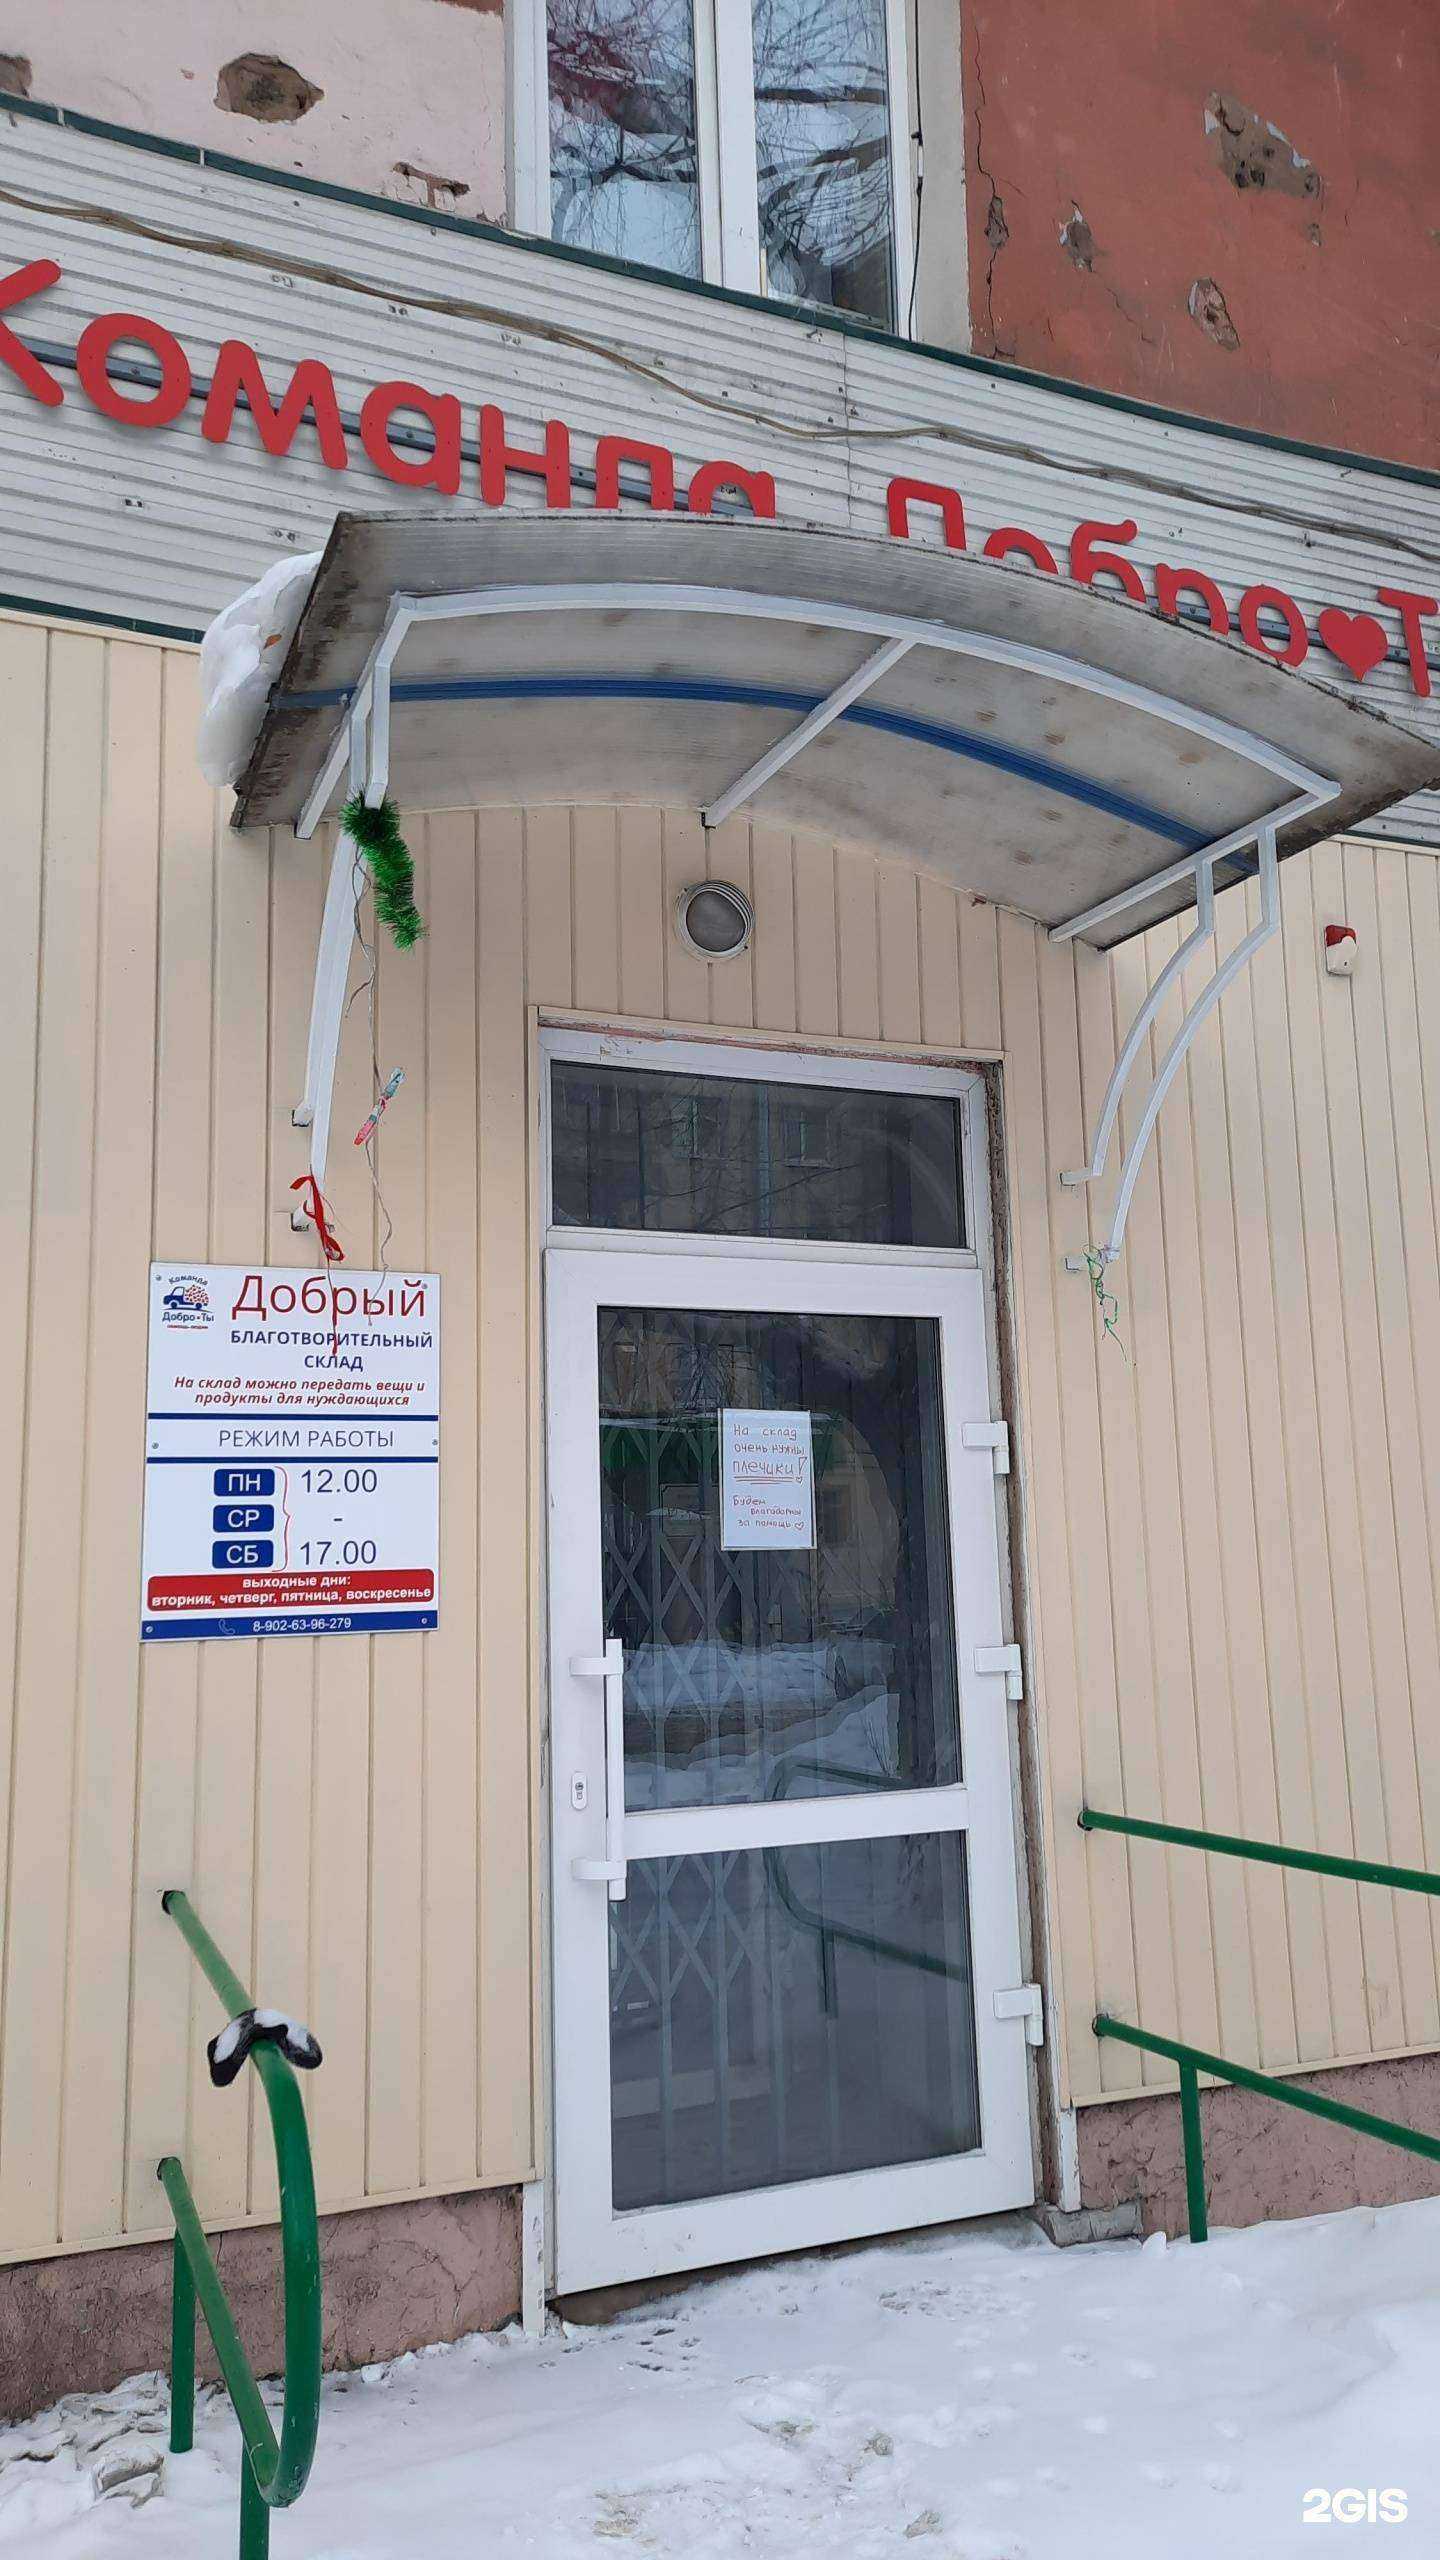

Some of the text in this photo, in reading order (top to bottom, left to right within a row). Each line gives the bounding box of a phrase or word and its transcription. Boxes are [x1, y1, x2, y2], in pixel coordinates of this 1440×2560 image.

[231, 1275, 426, 1325] Добрый
[230, 1330, 433, 1349] БЛАГОТВОРИТЕЛЬНЫЙ
[304, 1355, 364, 1372] СКЛАД
[174, 1376, 425, 1394] На склад можно передать вещи и
[194, 1392, 410, 1408] продукты для нуждающихся
[219, 1430, 394, 1448] РЕЖИМ РАБОТЫ
[733, 1424, 797, 1441] На склад
[734, 1444, 768, 1453] очень
[228, 1469, 377, 1493] ПН 12.00
[227, 1509, 259, 1528] СР
[226, 1540, 377, 1565] СБ 17.00
[243, 1576, 351, 1589] выходные дни:
[151, 1587, 431, 1607] вторник, четверг, пятница, воскресенье
[252, 1618, 352, 1631] 8-902-63-96-279
